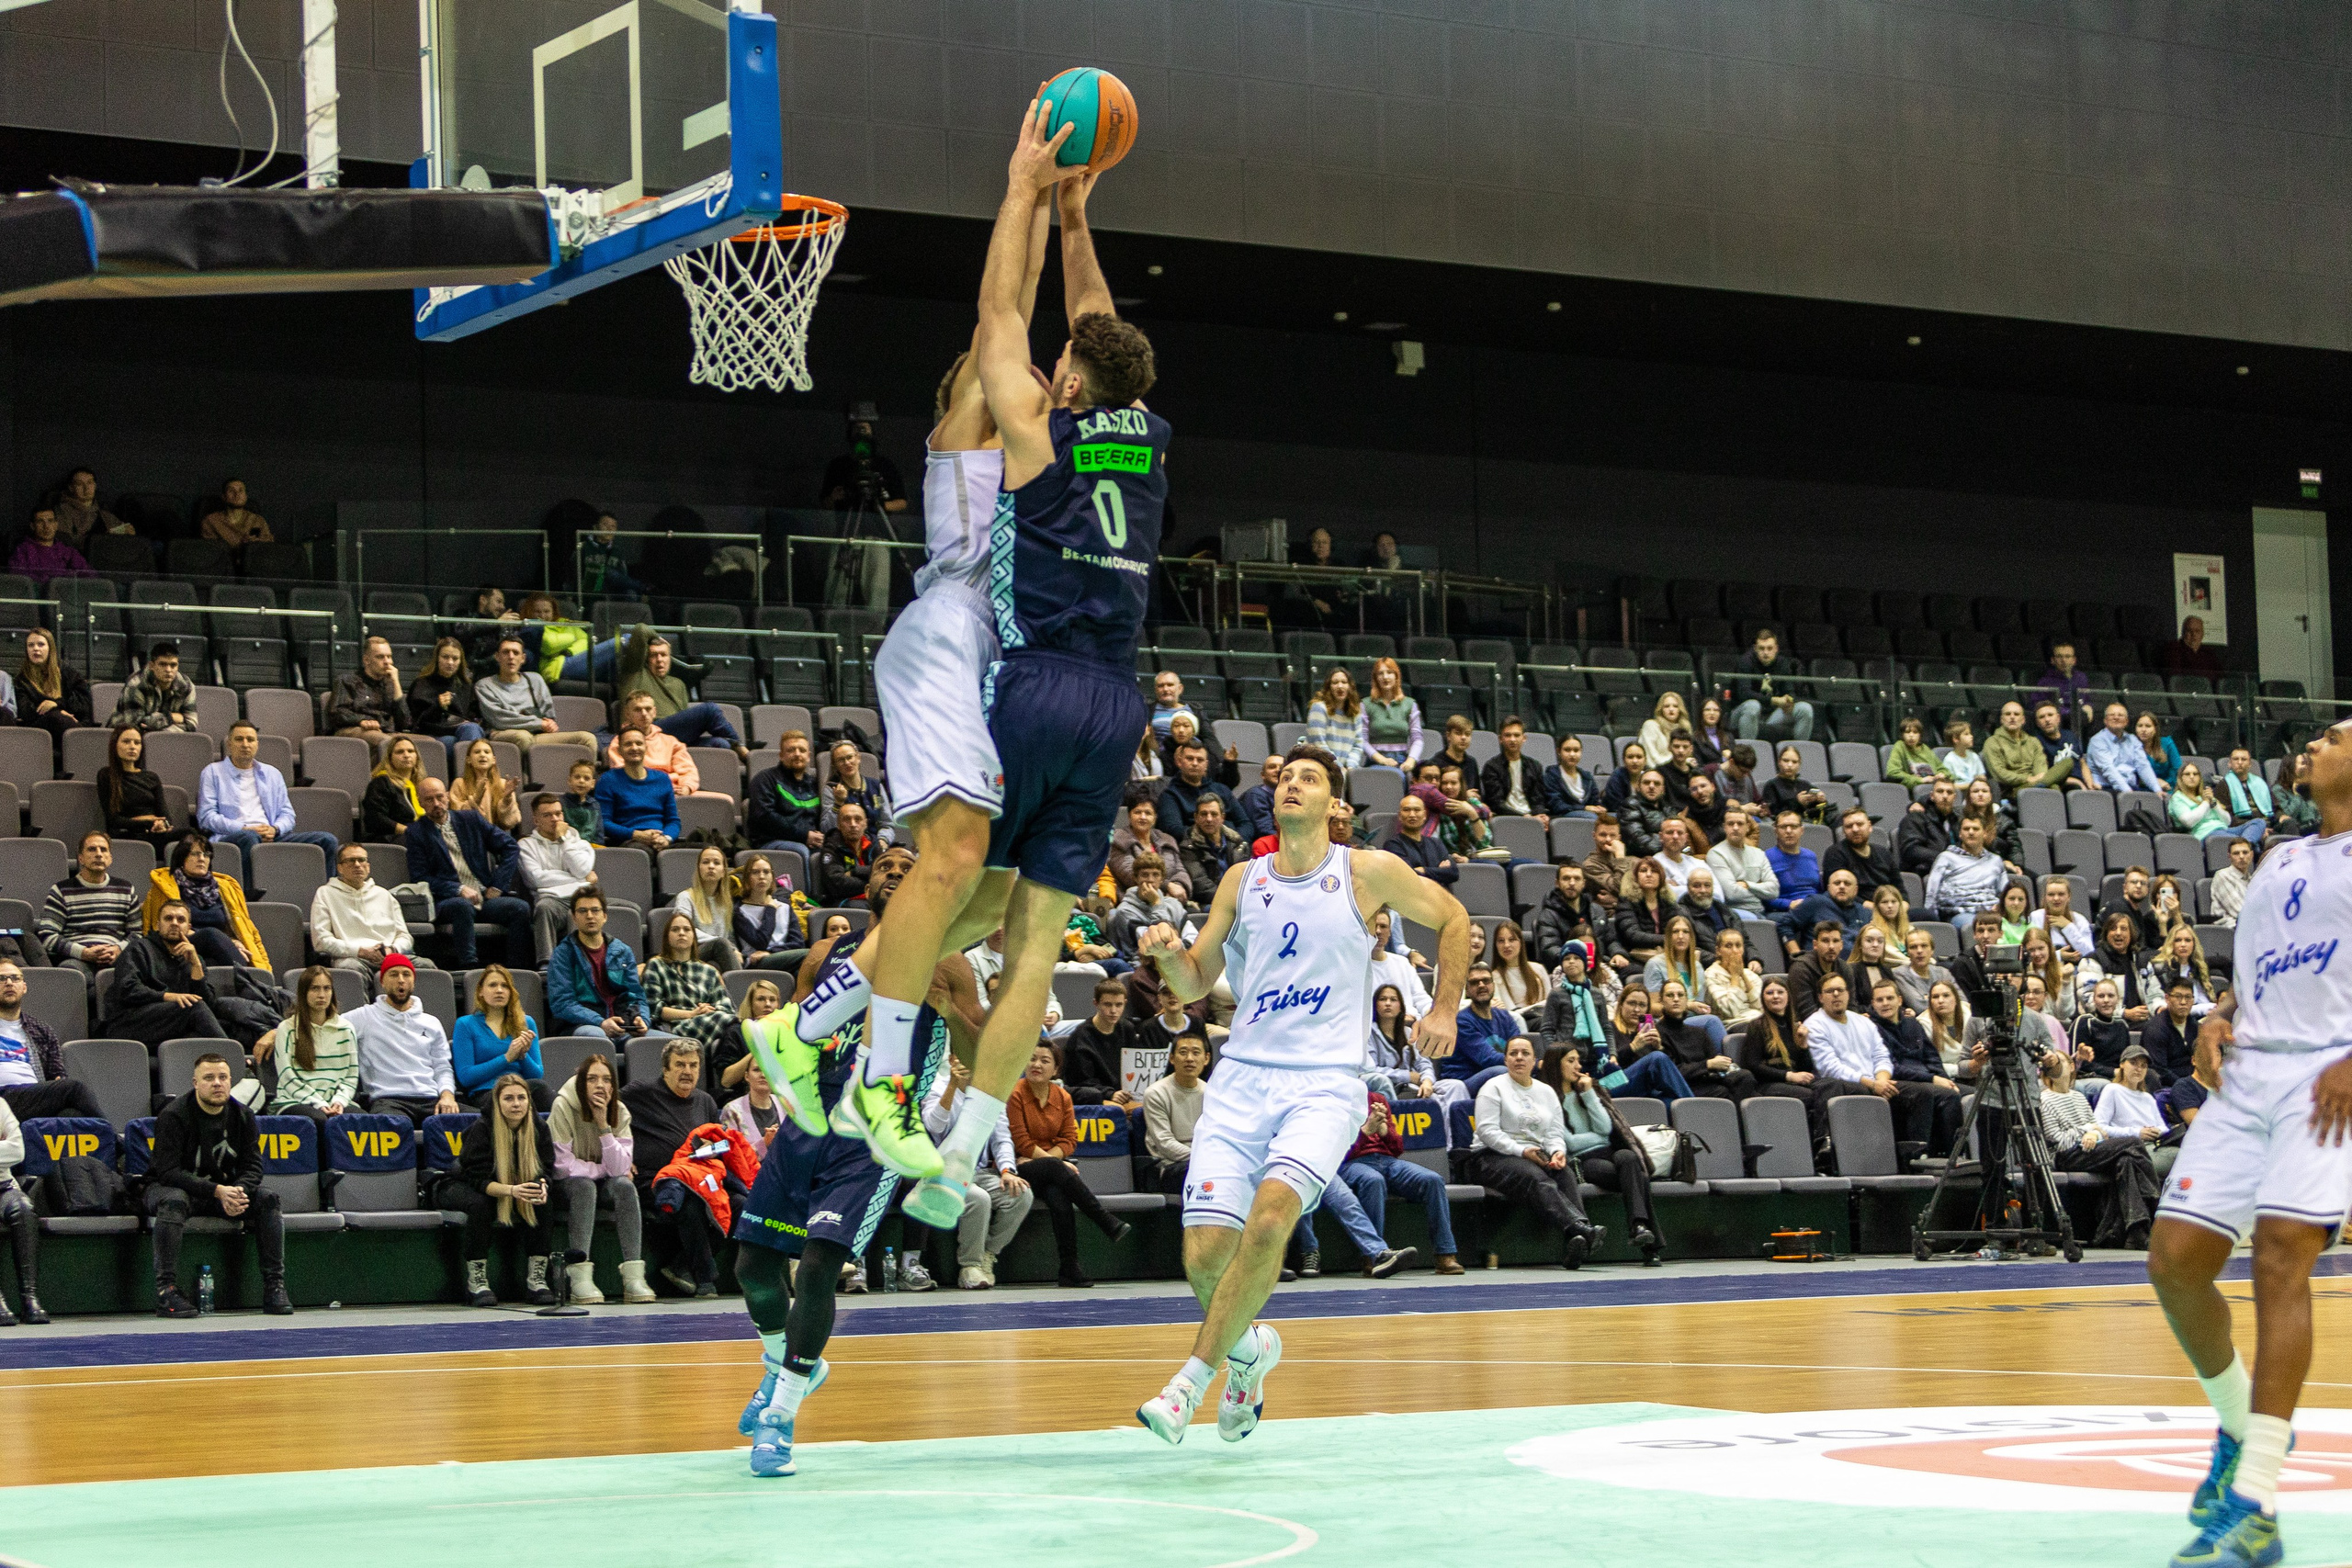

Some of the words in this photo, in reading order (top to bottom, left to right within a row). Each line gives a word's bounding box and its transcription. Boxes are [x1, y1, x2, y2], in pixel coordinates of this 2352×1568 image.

[1077, 409, 1148, 440] KASKO
[1080, 448, 1148, 467] BEERA
[1091, 479, 1127, 549] 0
[2284, 877, 2307, 920] 8
[1277, 921, 1299, 959] 2
[1135, 1051, 1169, 1068] ВПЕРЕ
[1074, 1118, 1115, 1142] VIP
[1391, 1112, 1431, 1136] VIP
[43, 1134, 100, 1161] VIP
[258, 1134, 300, 1159] VIP
[347, 1131, 401, 1156] VIP
[764, 1218, 808, 1237] еврооп
